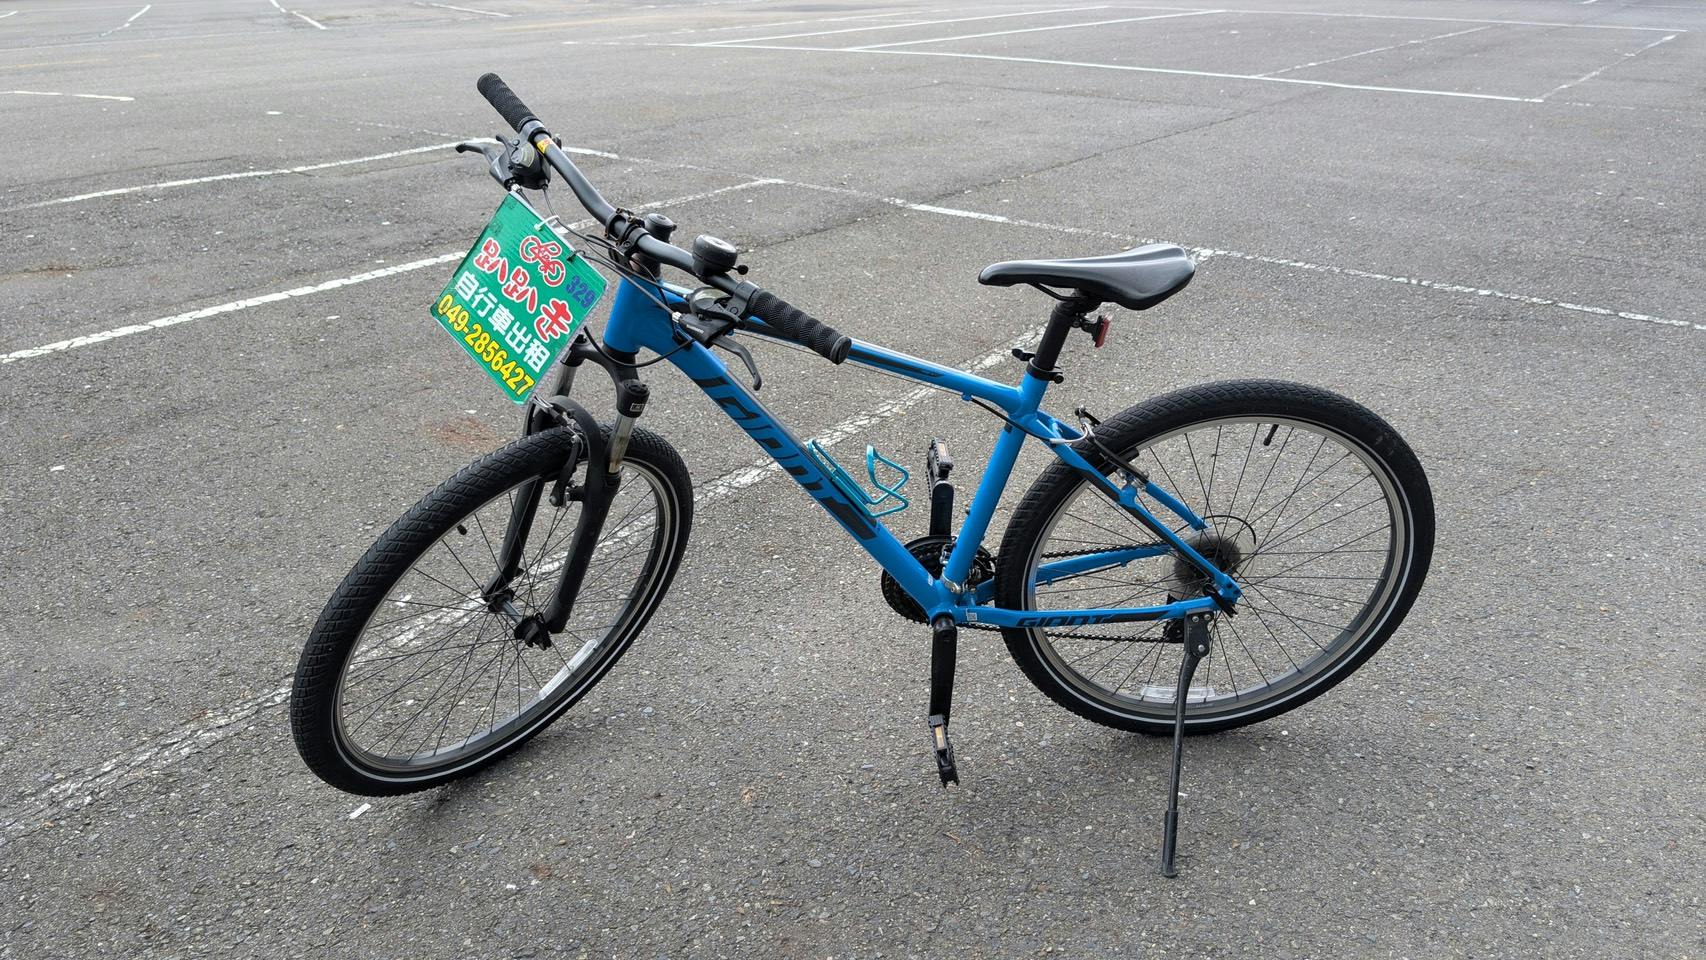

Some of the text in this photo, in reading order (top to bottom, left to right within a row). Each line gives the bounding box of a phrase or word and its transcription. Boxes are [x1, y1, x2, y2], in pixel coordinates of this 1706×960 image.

[455, 271, 551, 373] 自行車出租
[474, 236, 573, 343] 趴趴走
[565, 275, 597, 309] 329
[437, 294, 536, 397] 049-2856427
[702, 378, 850, 506] GIANT
[1016, 613, 1112, 628] GIANT
